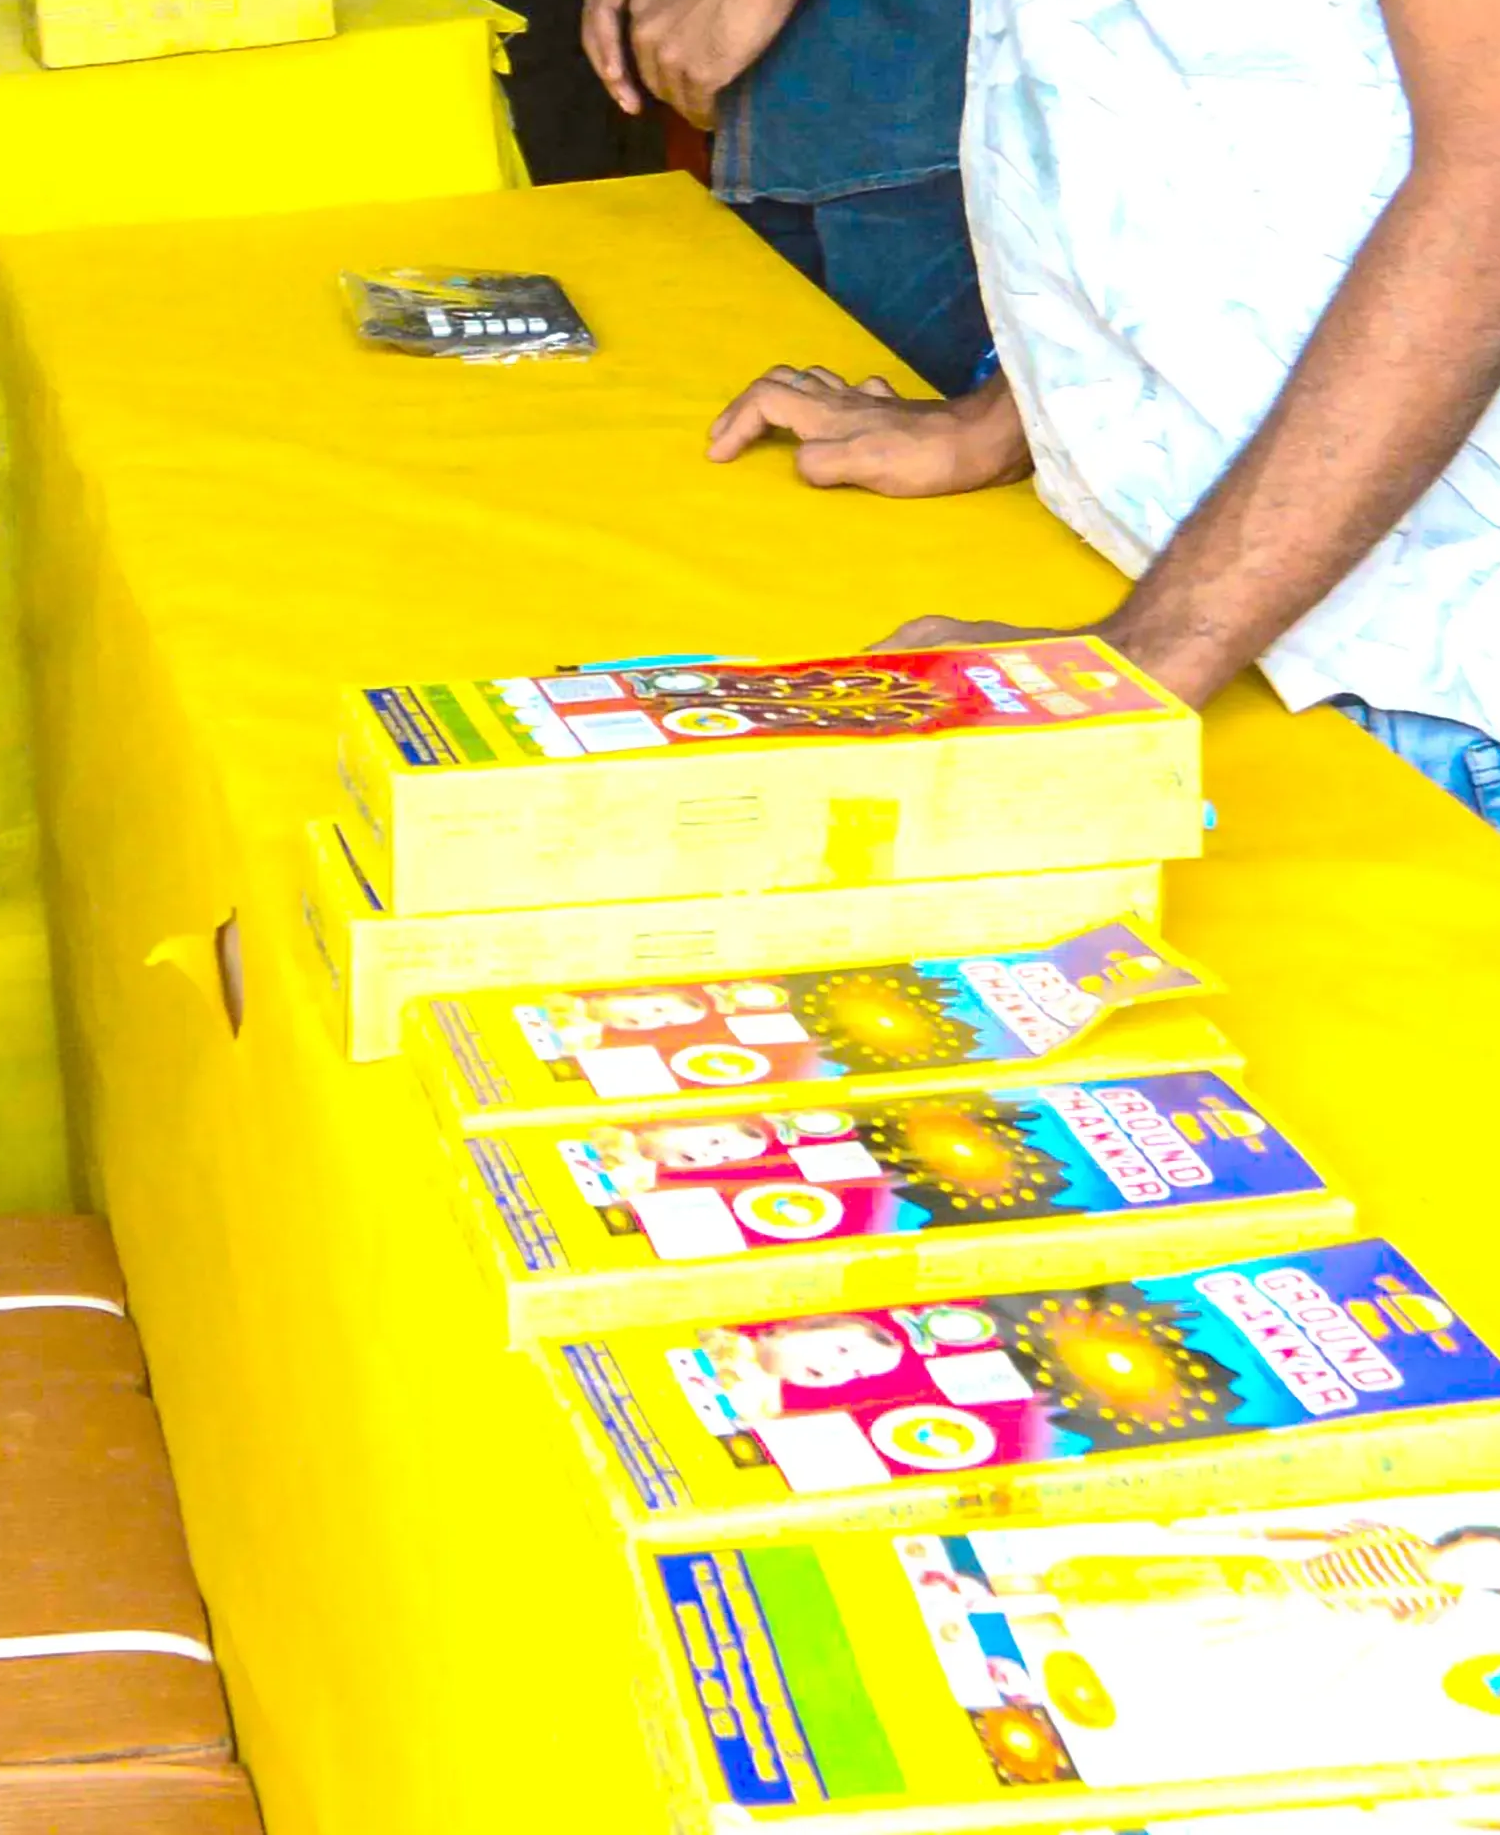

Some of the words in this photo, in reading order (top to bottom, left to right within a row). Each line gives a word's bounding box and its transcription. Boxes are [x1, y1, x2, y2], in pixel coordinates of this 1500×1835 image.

[1099, 1089, 1207, 1184] GROUND
[1200, 1275, 1350, 1407] CHAKKAR
[1262, 1271, 1396, 1385] GROUND
